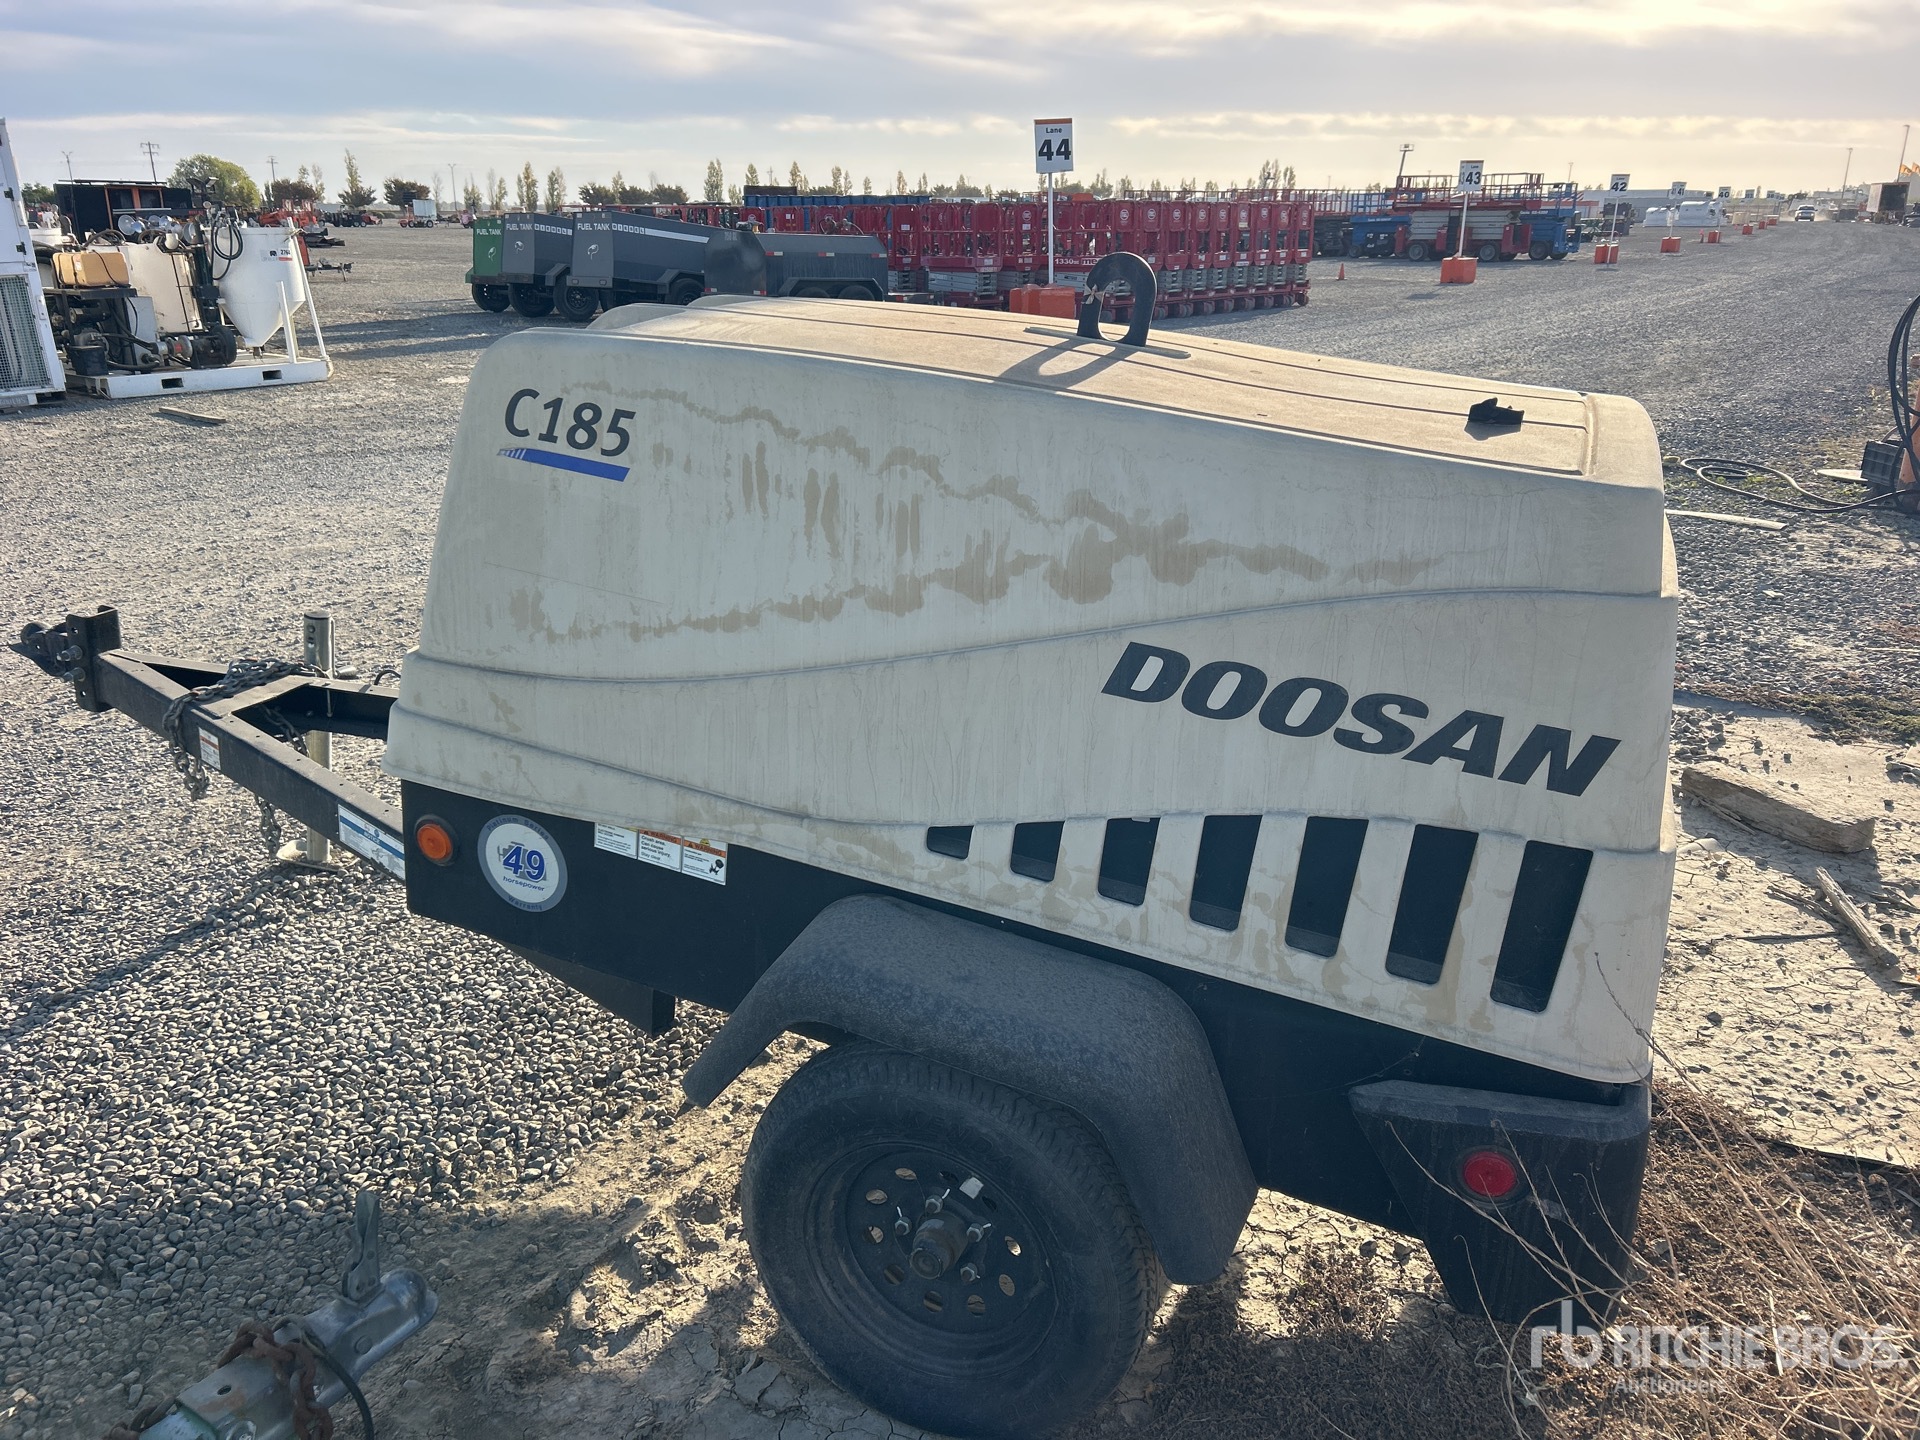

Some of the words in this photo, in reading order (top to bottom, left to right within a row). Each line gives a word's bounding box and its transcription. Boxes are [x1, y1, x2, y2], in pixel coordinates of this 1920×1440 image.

[1038, 138, 1071, 161] 44
[1465, 171, 1482, 185] 43
[1611, 181, 1627, 192] 42
[506, 223, 519, 231] FUEL
[520, 223, 533, 231] TANK
[577, 223, 592, 231] FUEL
[594, 223, 610, 231] TANK
[505, 388, 636, 457] C185
[1101, 641, 1622, 797] DOOSAN
[524, 819, 549, 840] Series
[641, 846, 657, 854] serious
[502, 845, 546, 882] 49
[503, 876, 545, 892] horsepower
